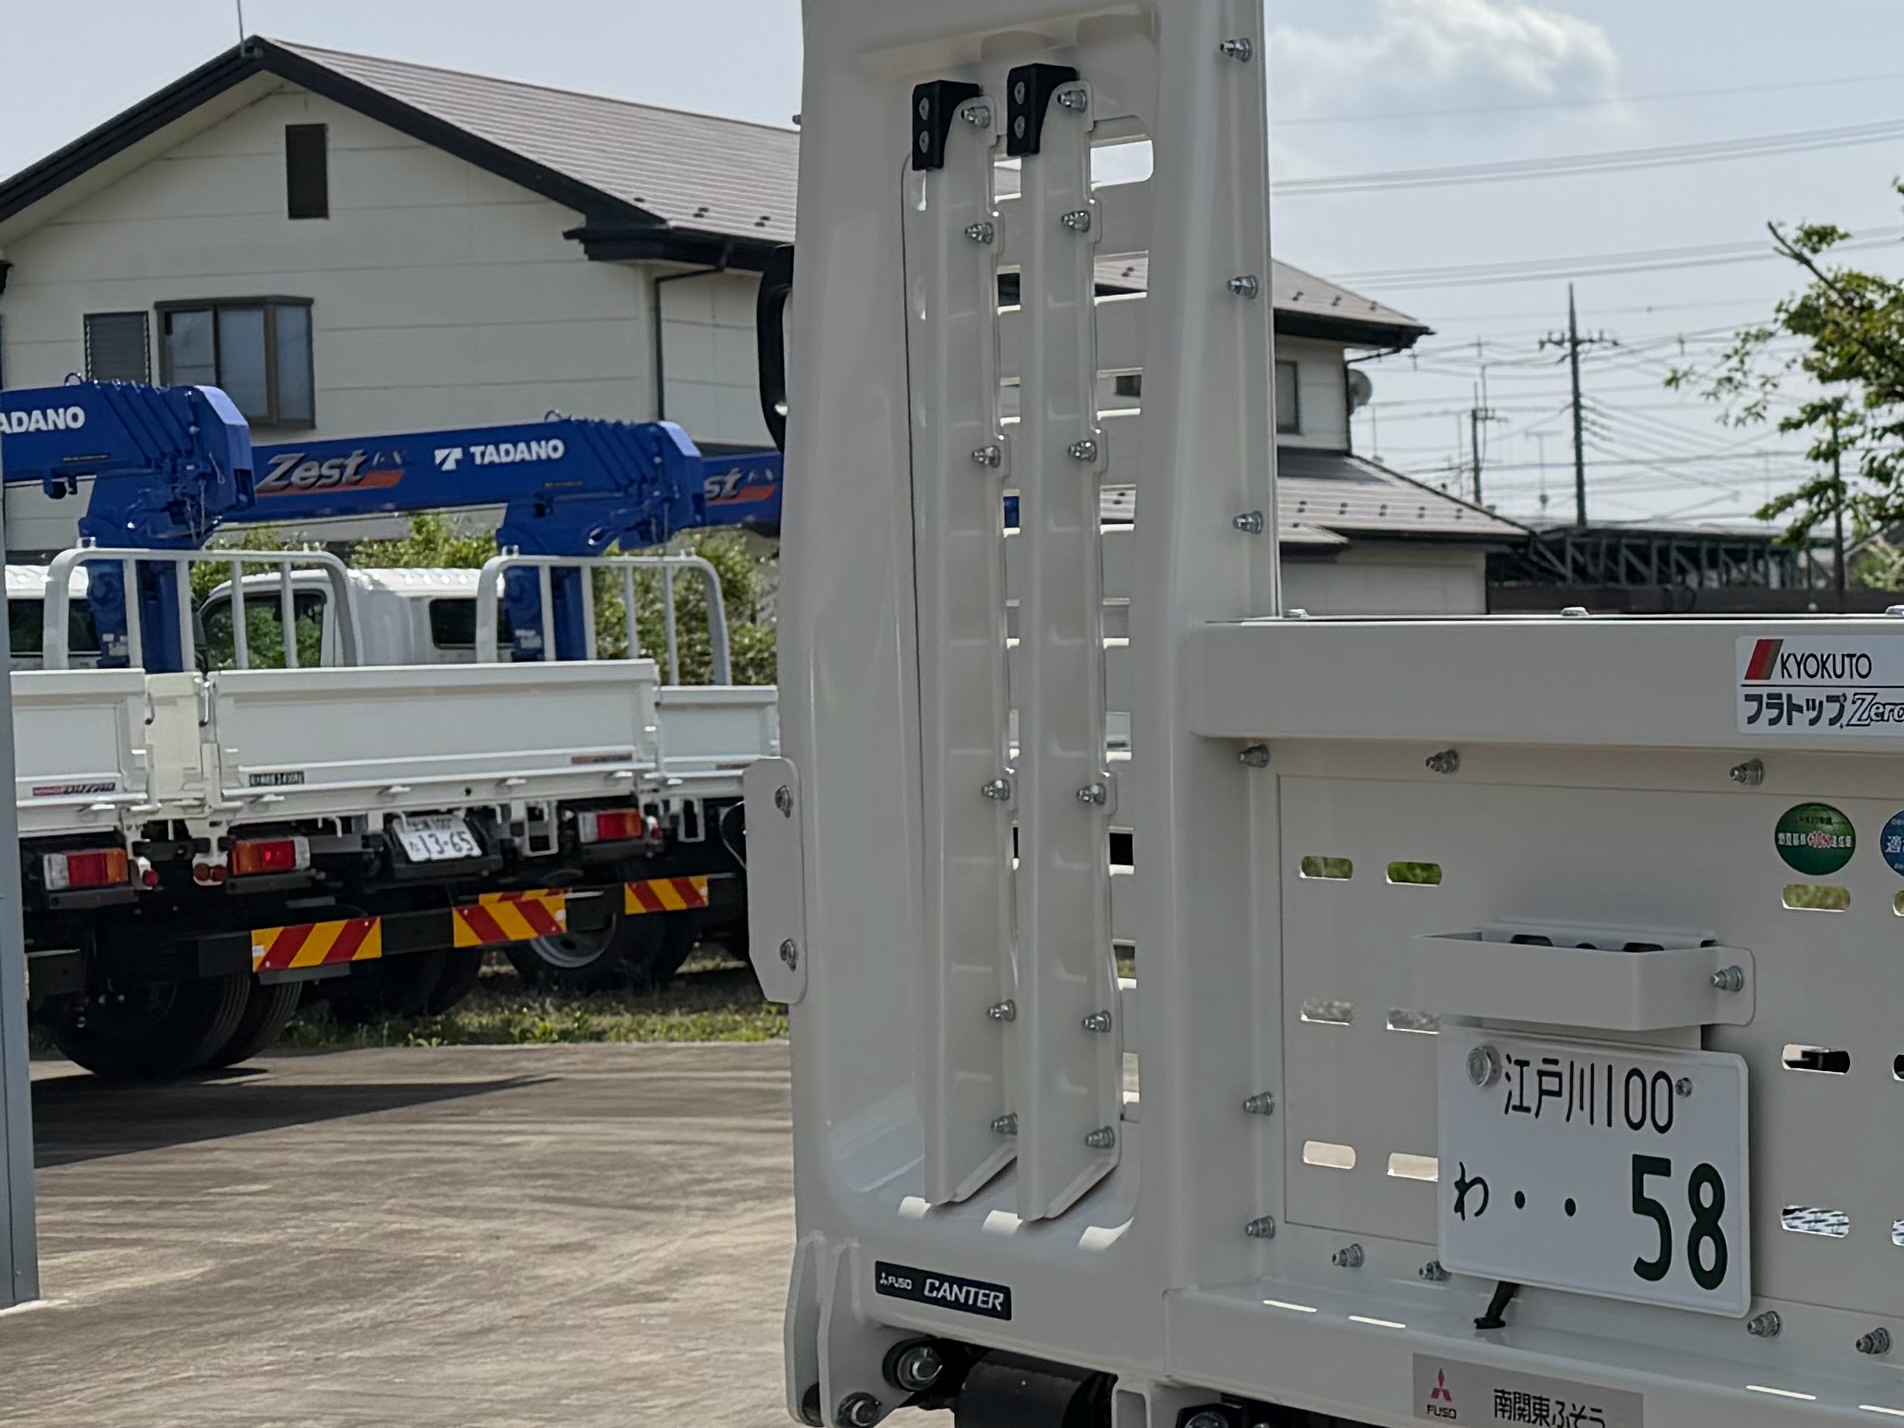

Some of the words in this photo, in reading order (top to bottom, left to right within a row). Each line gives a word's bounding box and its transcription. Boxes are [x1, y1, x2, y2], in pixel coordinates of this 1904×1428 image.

[469, 439, 565, 465] TADANO
[256, 449, 369, 491] Zest
[1780, 653, 1873, 679] KYOKUTO
[887, 1275, 913, 1290] FUSO
[923, 1278, 1004, 1311] CANTER
[1426, 1404, 1457, 1420] FUSO
